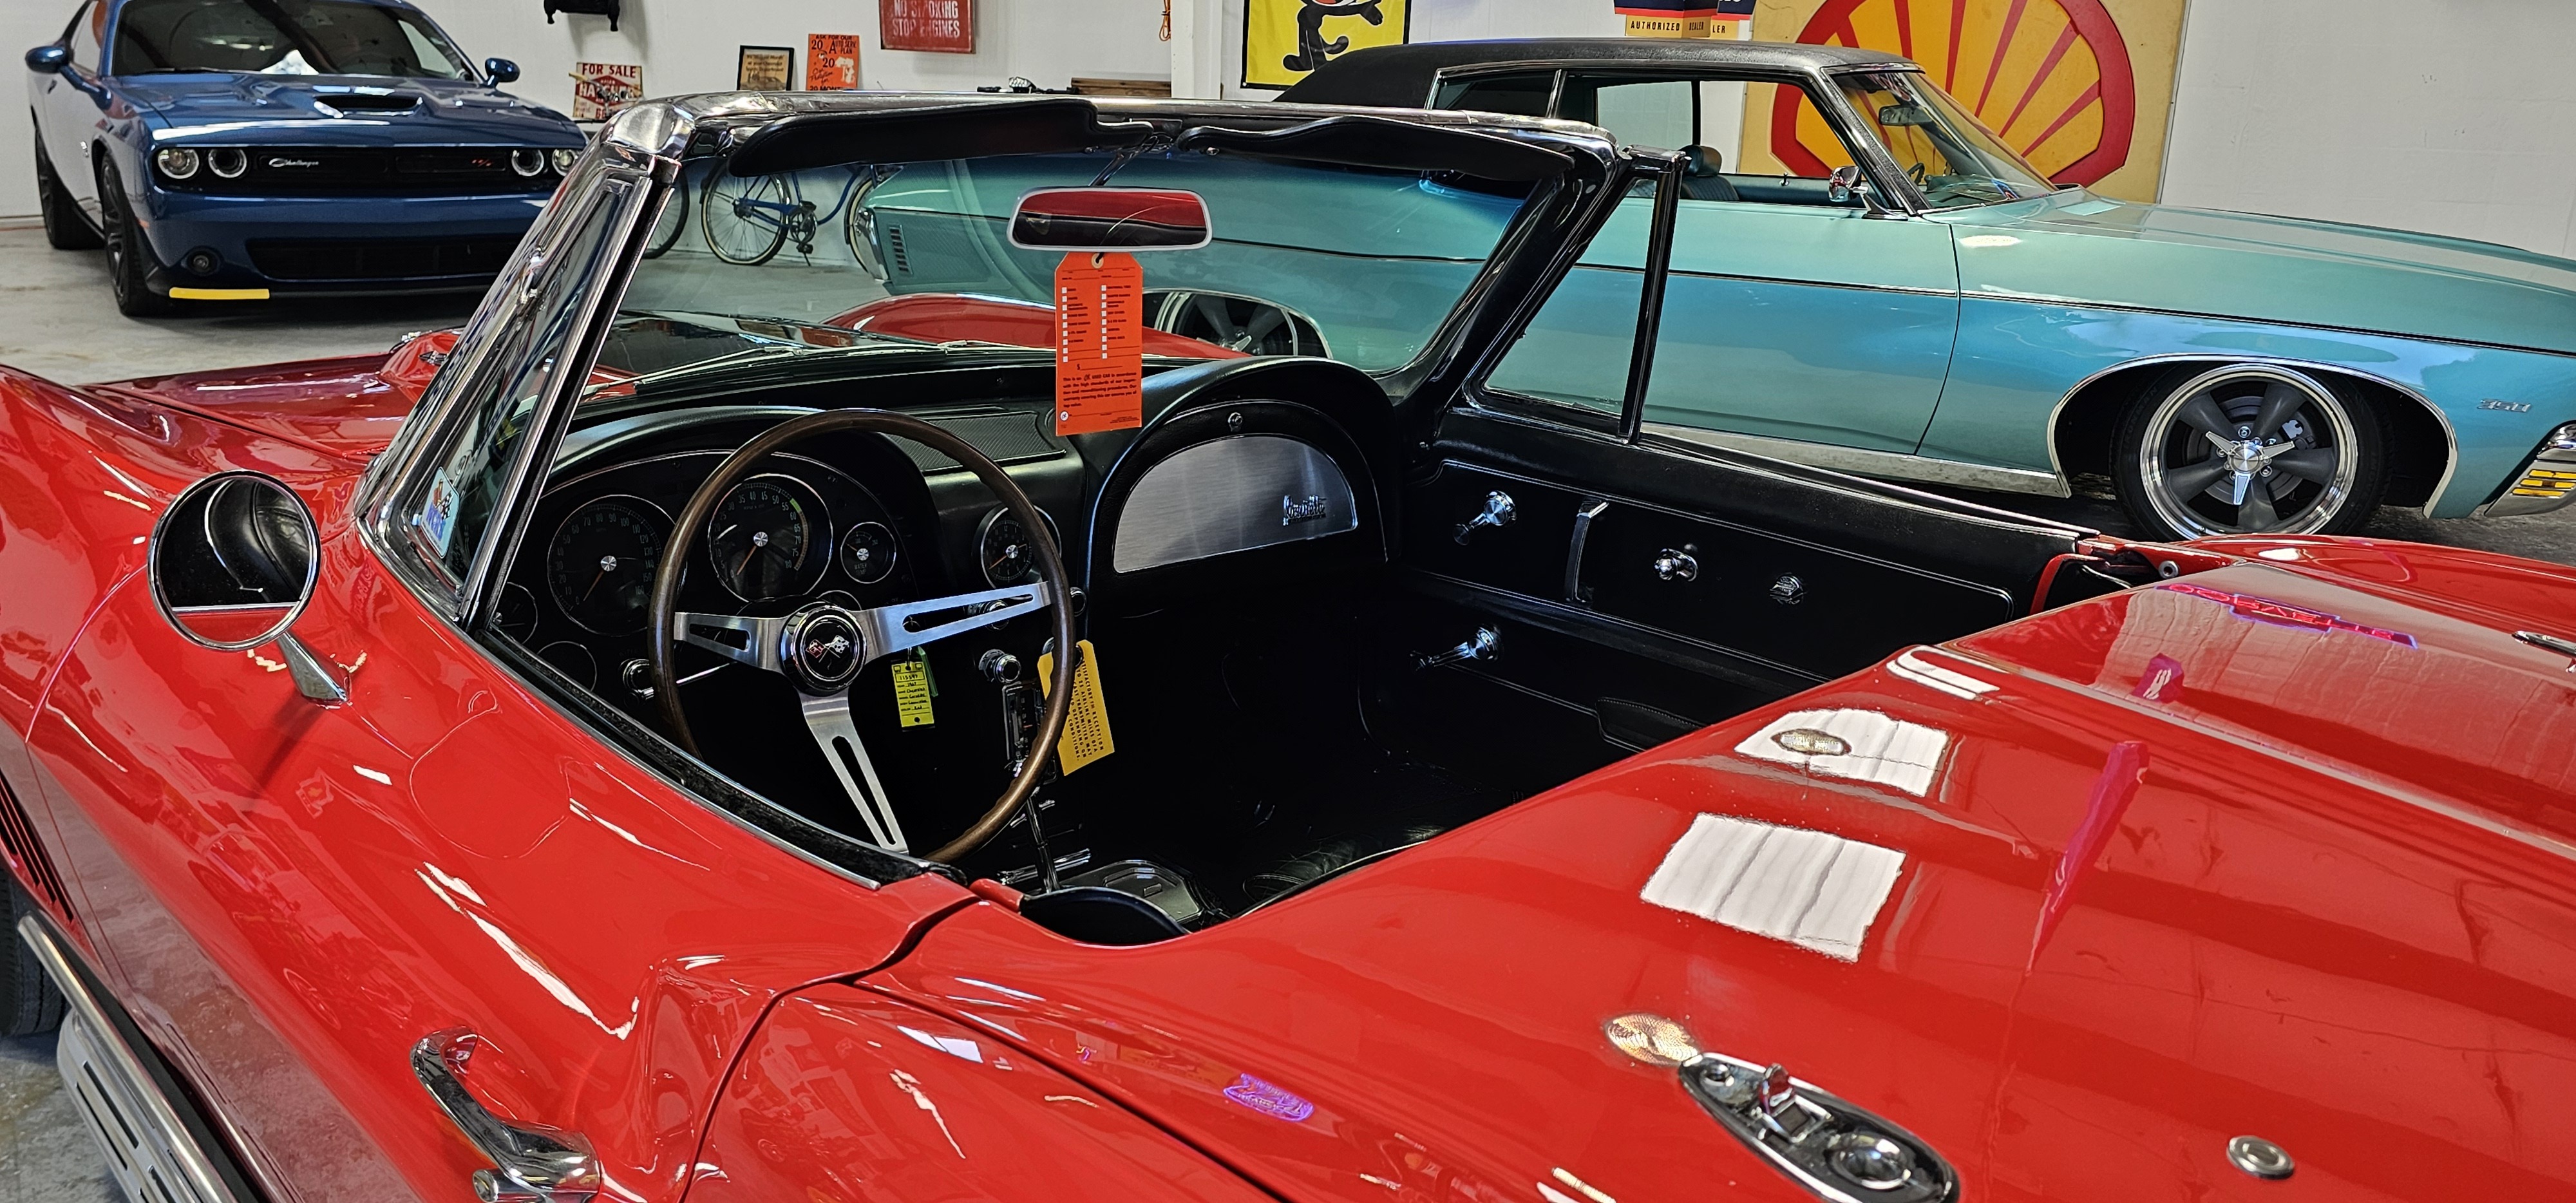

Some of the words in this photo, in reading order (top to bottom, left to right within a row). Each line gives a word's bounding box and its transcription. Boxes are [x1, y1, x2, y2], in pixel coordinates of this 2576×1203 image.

[894, 0, 907, 17] NO
[911, 0, 958, 18] SMOKING
[893, 18, 916, 36] STOP
[920, 20, 960, 38] ENGINES
[1631, 21, 1680, 32] AUTHORIZED
[1689, 21, 1704, 31] DEALER
[1712, 24, 1726, 33] LER
[811, 39, 823, 50] 20
[822, 57, 835, 68] 20
[582, 63, 603, 75] FOR
[609, 65, 636, 78] SALE
[2477, 399, 2532, 412] 350
[739, 495, 746, 504] 35
[761, 491, 768, 500] 45
[772, 495, 779, 504] 50
[782, 502, 789, 511] 55
[1283, 495, 1327, 525] Corvette
[609, 513, 616, 522] 90
[790, 511, 797, 520] 60
[583, 516, 591, 526] 70
[794, 523, 801, 533] 65
[639, 535, 649, 544] 120
[795, 536, 801, 545] 70
[644, 547, 653, 556] 130
[792, 547, 799, 556] 75
[1076, 669, 1081, 677] TO
[1079, 680, 1084, 688] 25
[1081, 691, 1090, 716] AIRLINE
[1081, 661, 1093, 699] ATISFACTORY
[1092, 711, 1104, 751] RECEPTION
[1076, 698, 1088, 741] TRANSMITTER
[1072, 708, 1083, 746] DEPENDING
[1081, 749, 1086, 758] ON
[1087, 719, 1095, 737] MILES
[1068, 719, 1080, 761] CONDITIONS.
